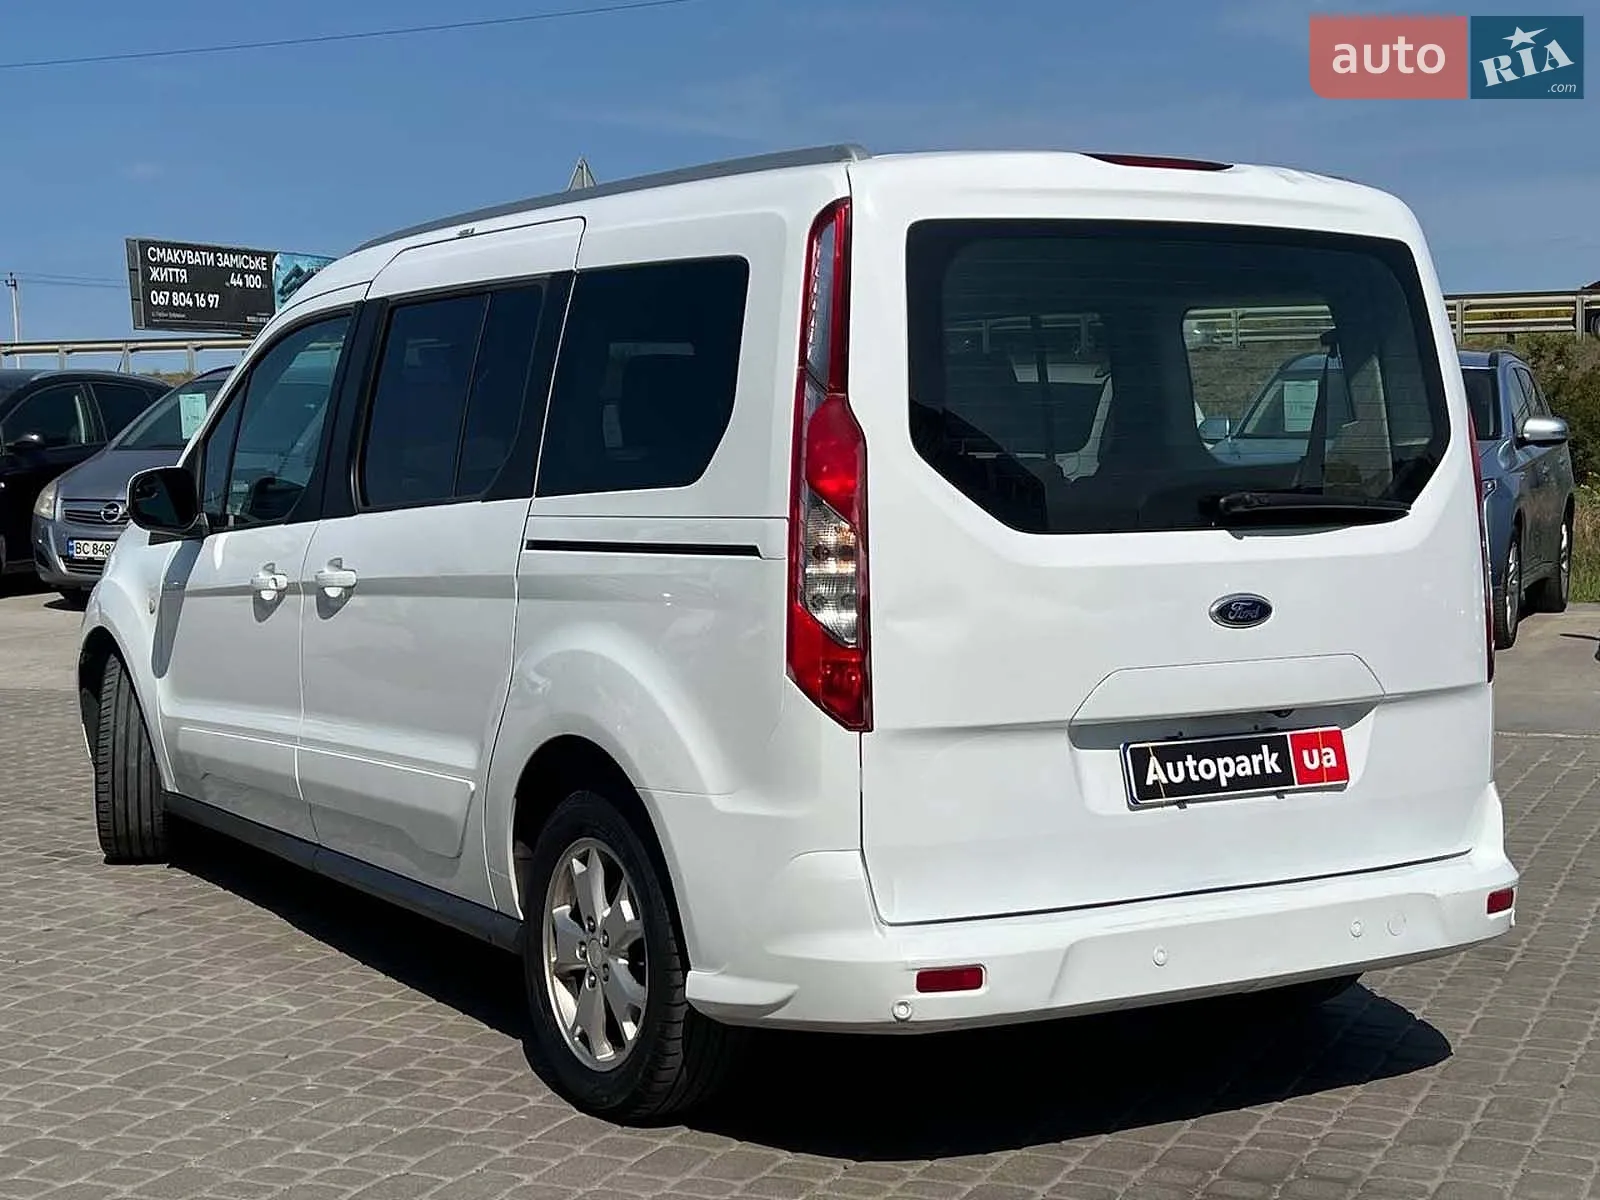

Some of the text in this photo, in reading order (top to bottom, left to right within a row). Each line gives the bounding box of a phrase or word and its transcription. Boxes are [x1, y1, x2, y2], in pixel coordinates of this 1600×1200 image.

[147, 246, 268, 271] СМАКУВАТИ ЗАМІСЬКЕ
[149, 266, 188, 284] ЖИТТЯ
[230, 273, 243, 288] 44
[244, 274, 262, 289] 100
[150, 290, 220, 309] 067 804 16 97
[75, 542, 90, 555] BC
[1228, 601, 1261, 620] Ford
[1146, 744, 1337, 787] Autopark ua
